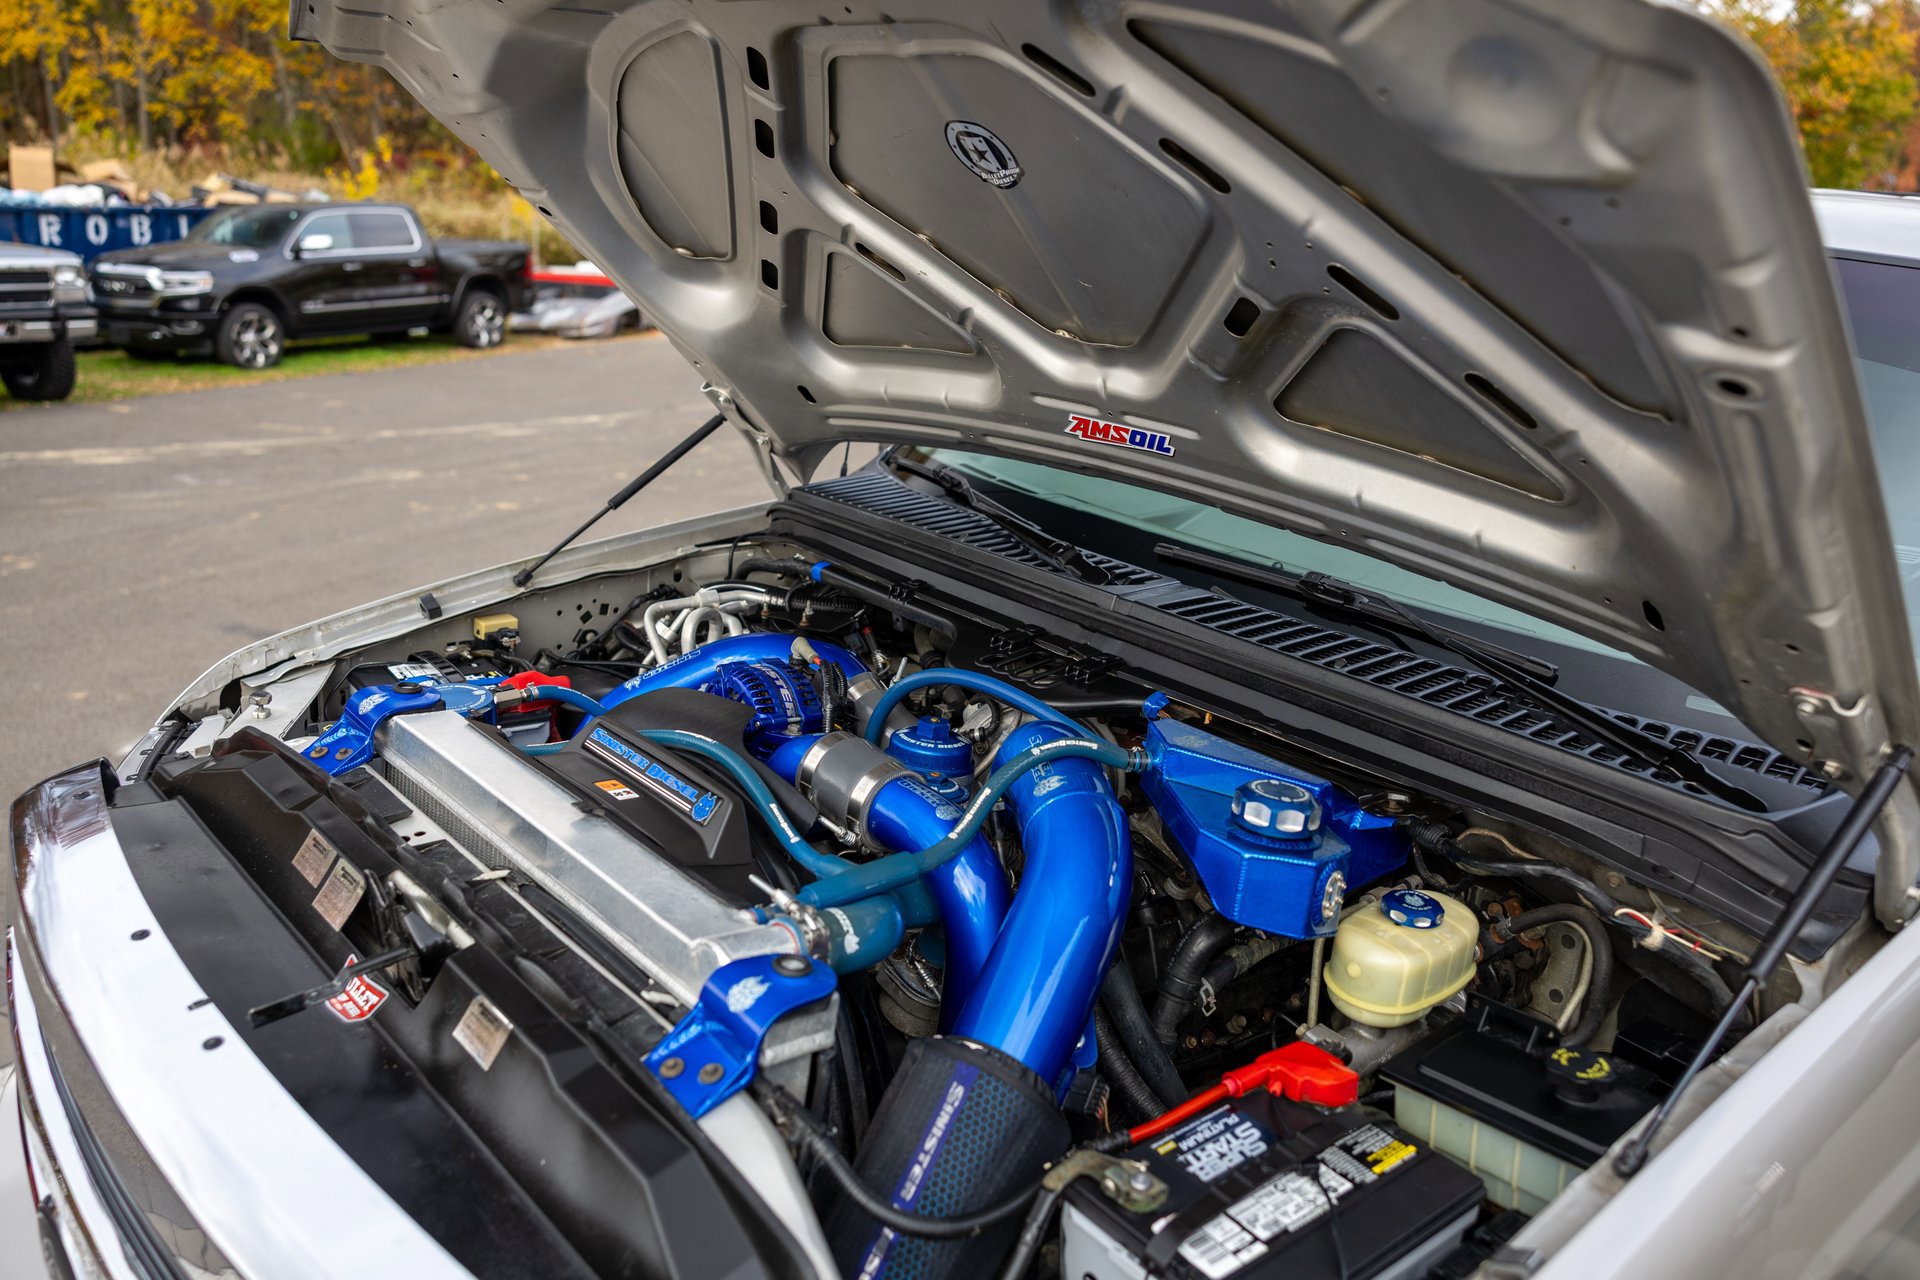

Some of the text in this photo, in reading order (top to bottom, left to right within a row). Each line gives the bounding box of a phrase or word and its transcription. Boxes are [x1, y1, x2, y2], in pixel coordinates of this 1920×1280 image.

[1069, 415, 1173, 454] AMSOIL
[589, 727, 700, 803] SINISTER DIESEL
[345, 977, 380, 1011] ULLET
[900, 1081, 965, 1202] SINISTER
[1178, 1113, 1240, 1151] PLATINUM
[1185, 1121, 1262, 1173] START
[1198, 1140, 1268, 1182] SUPER
